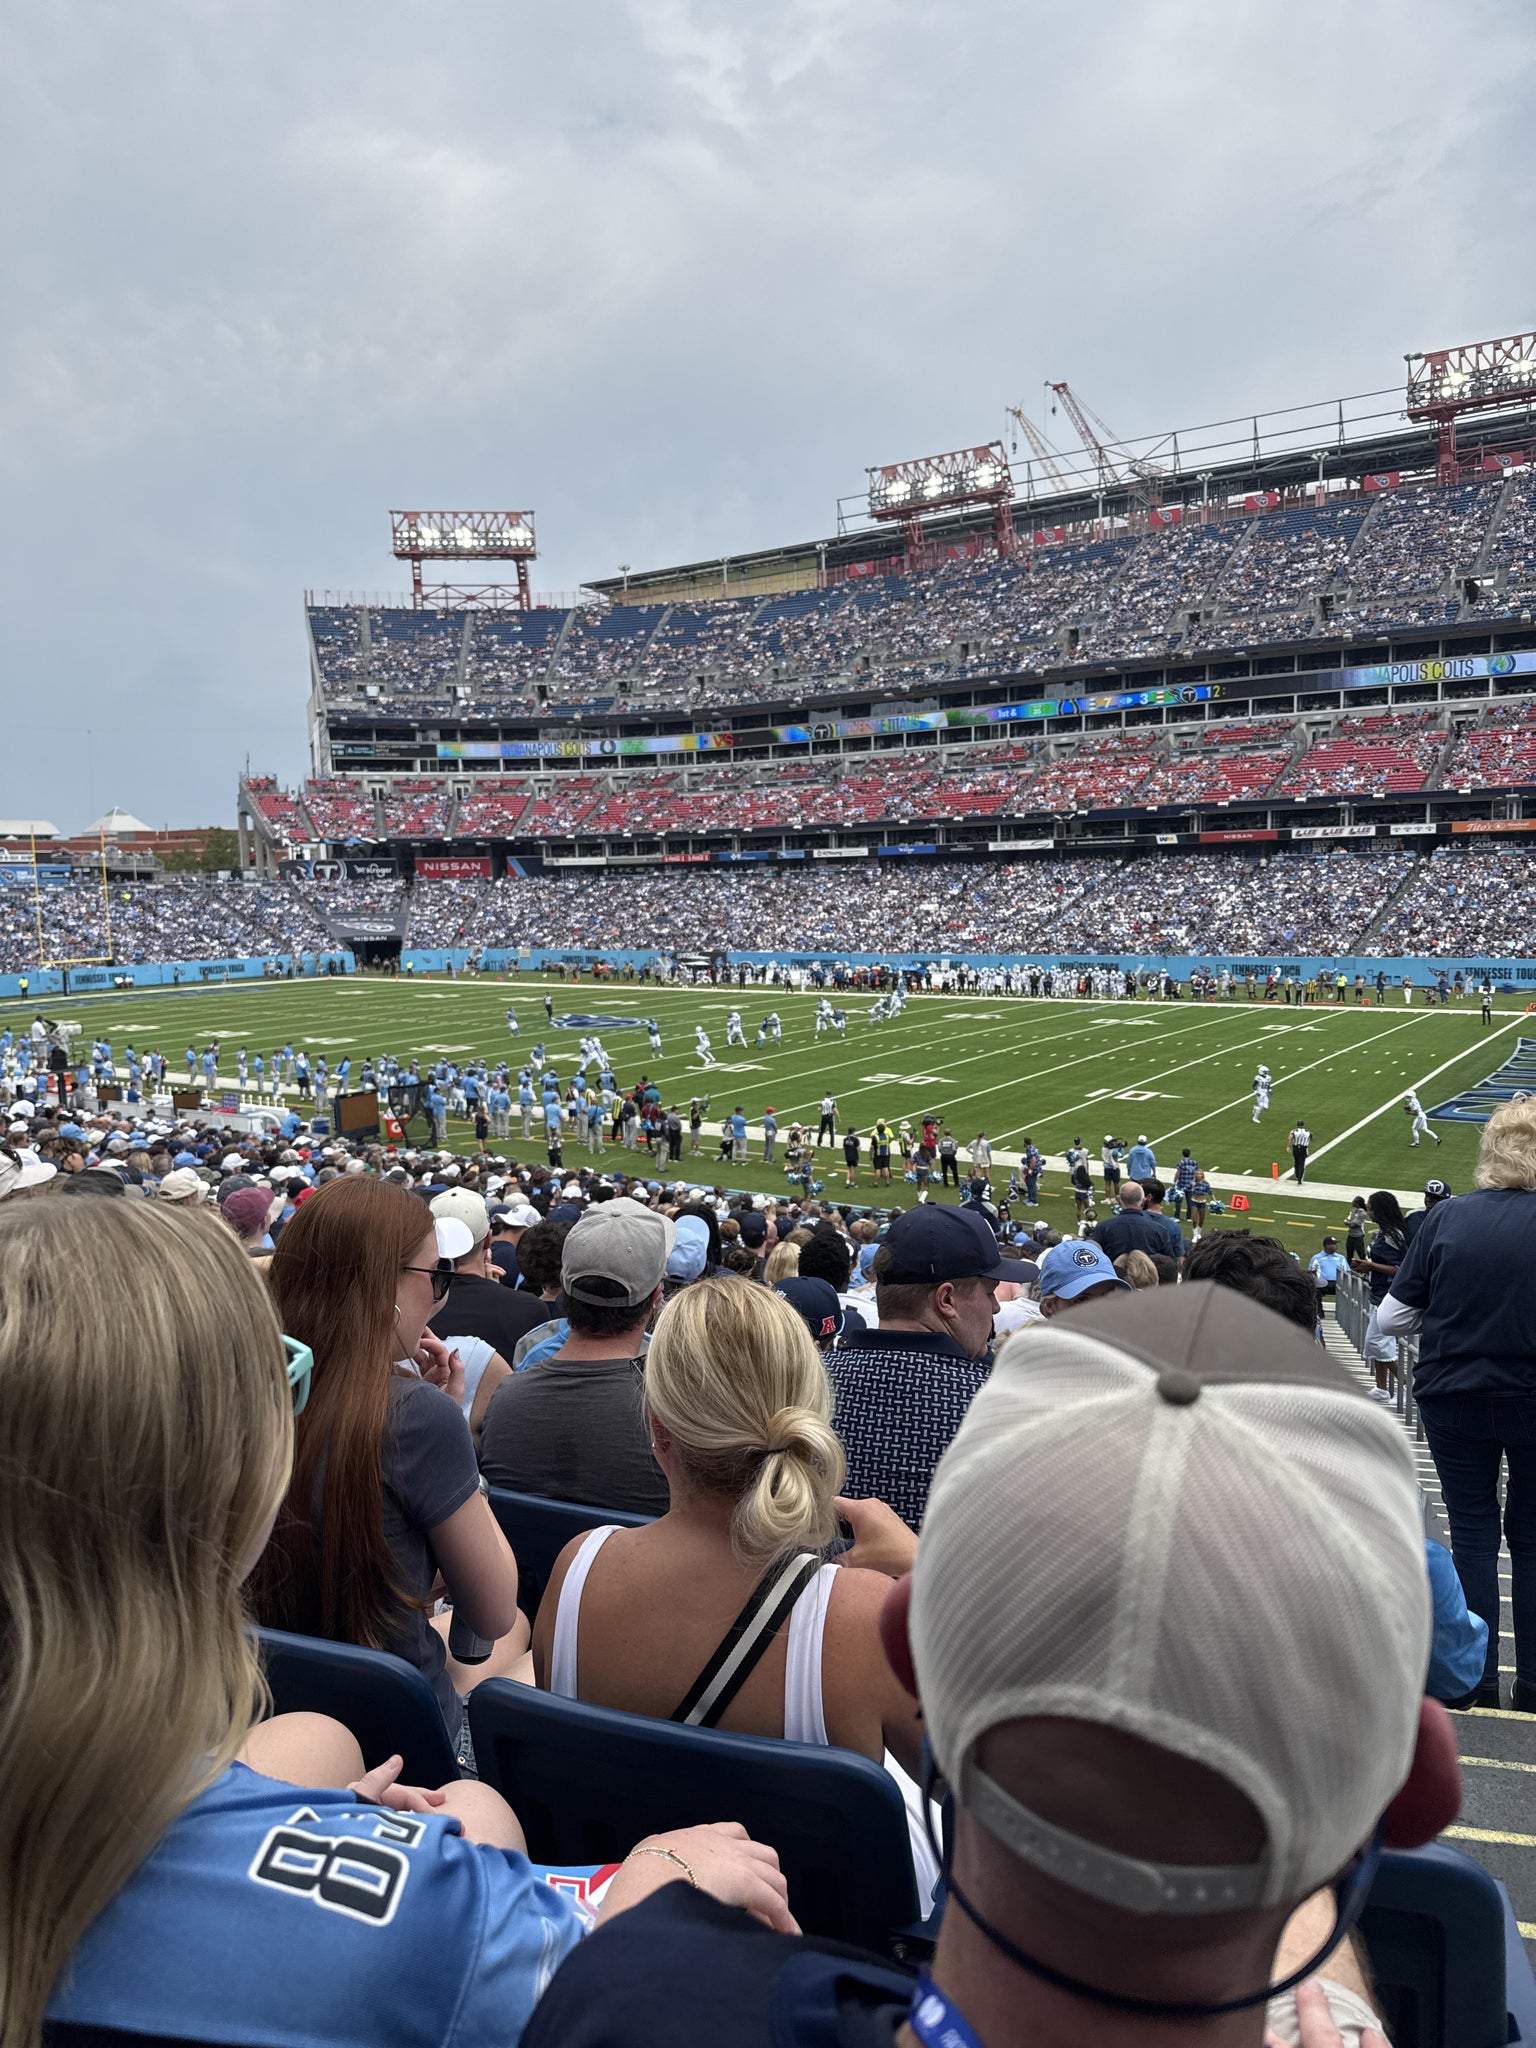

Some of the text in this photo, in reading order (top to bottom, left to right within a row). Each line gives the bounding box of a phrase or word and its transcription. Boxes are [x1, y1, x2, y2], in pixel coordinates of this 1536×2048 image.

[1432, 658, 1474, 679] COLTS
[1103, 697, 1112, 708] 7
[1140, 693, 1149, 704] 3
[712, 733, 734, 748] VS
[1466, 822, 1492, 832] Tito's
[424, 862, 481, 871] NISSAN
[1465, 967, 1512, 980] TENNESSEE
[858, 1073, 944, 1085] 20
[1084, 1088, 1162, 1101] 10
[1234, 1196, 1243, 1208] G
[820, 1315, 836, 1336] A
